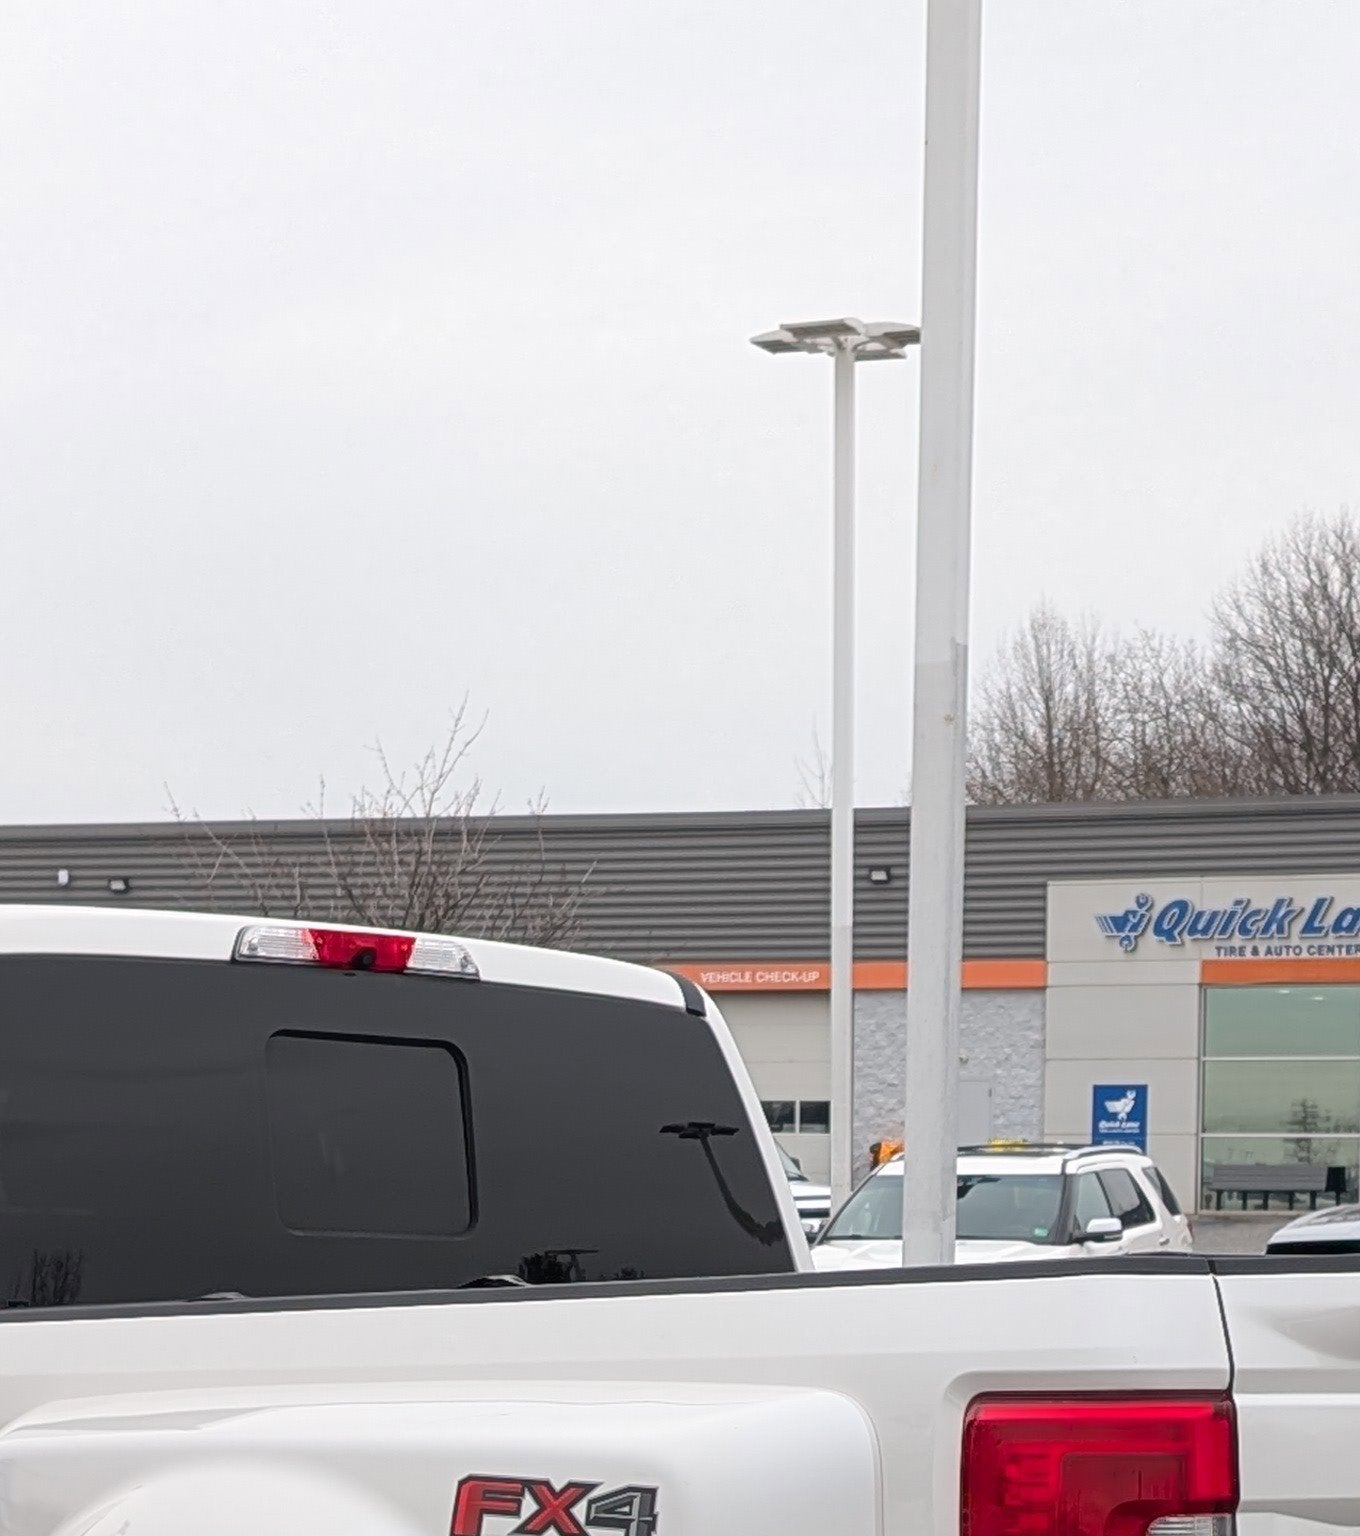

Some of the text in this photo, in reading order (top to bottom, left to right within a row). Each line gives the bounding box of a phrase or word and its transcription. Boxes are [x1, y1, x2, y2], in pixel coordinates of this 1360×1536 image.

[1152, 896, 1305, 945] Quick
[1215, 945, 1247, 957] TIRE
[1251, 945, 1261, 957] &
[1264, 945, 1303, 957] AUTO
[700, 970, 820, 983] VEHICLE CHECK-UP
